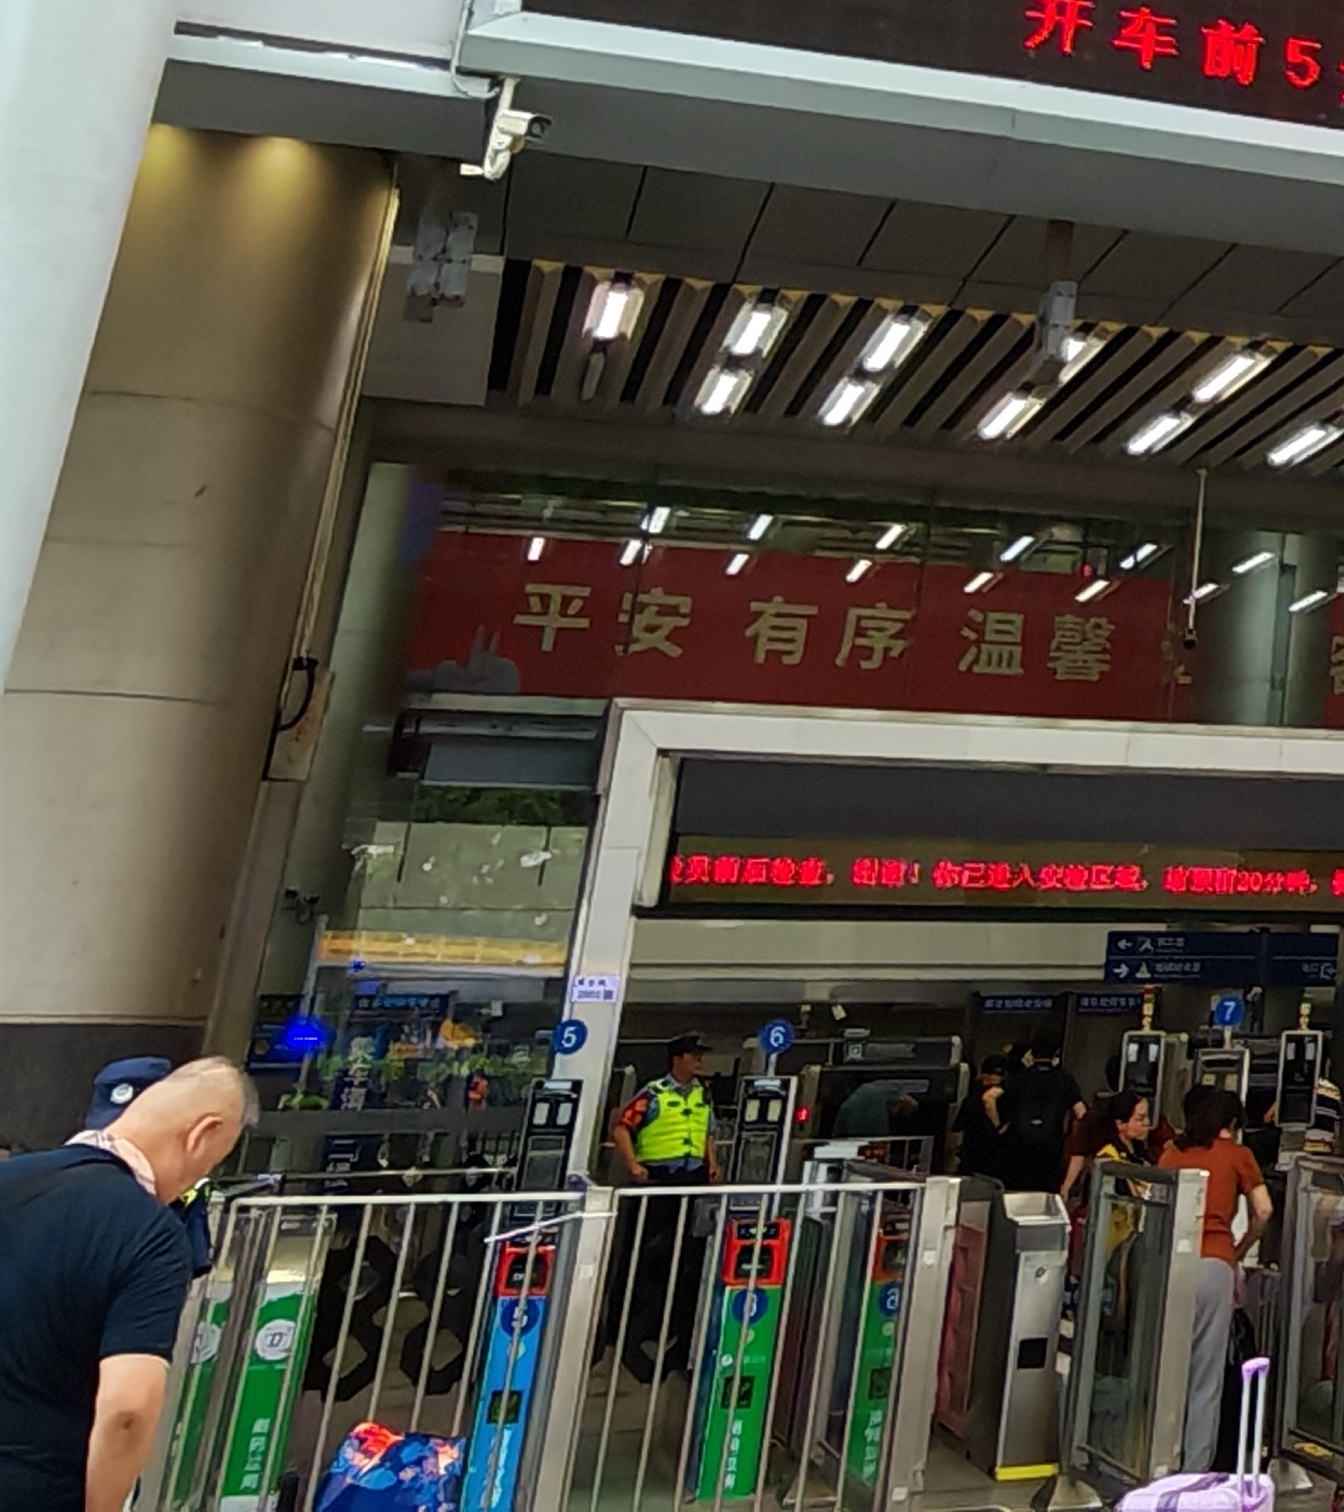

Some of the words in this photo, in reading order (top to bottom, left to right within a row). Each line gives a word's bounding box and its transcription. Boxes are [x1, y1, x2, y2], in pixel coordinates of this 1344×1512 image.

[514, 583, 692, 659] 平安
[743, 595, 916, 668] 有序
[957, 607, 1115, 682] 温馨
[1223, 1001, 1237, 1021] 7
[561, 1026, 578, 1048] 5
[770, 1026, 784, 1048] 6
